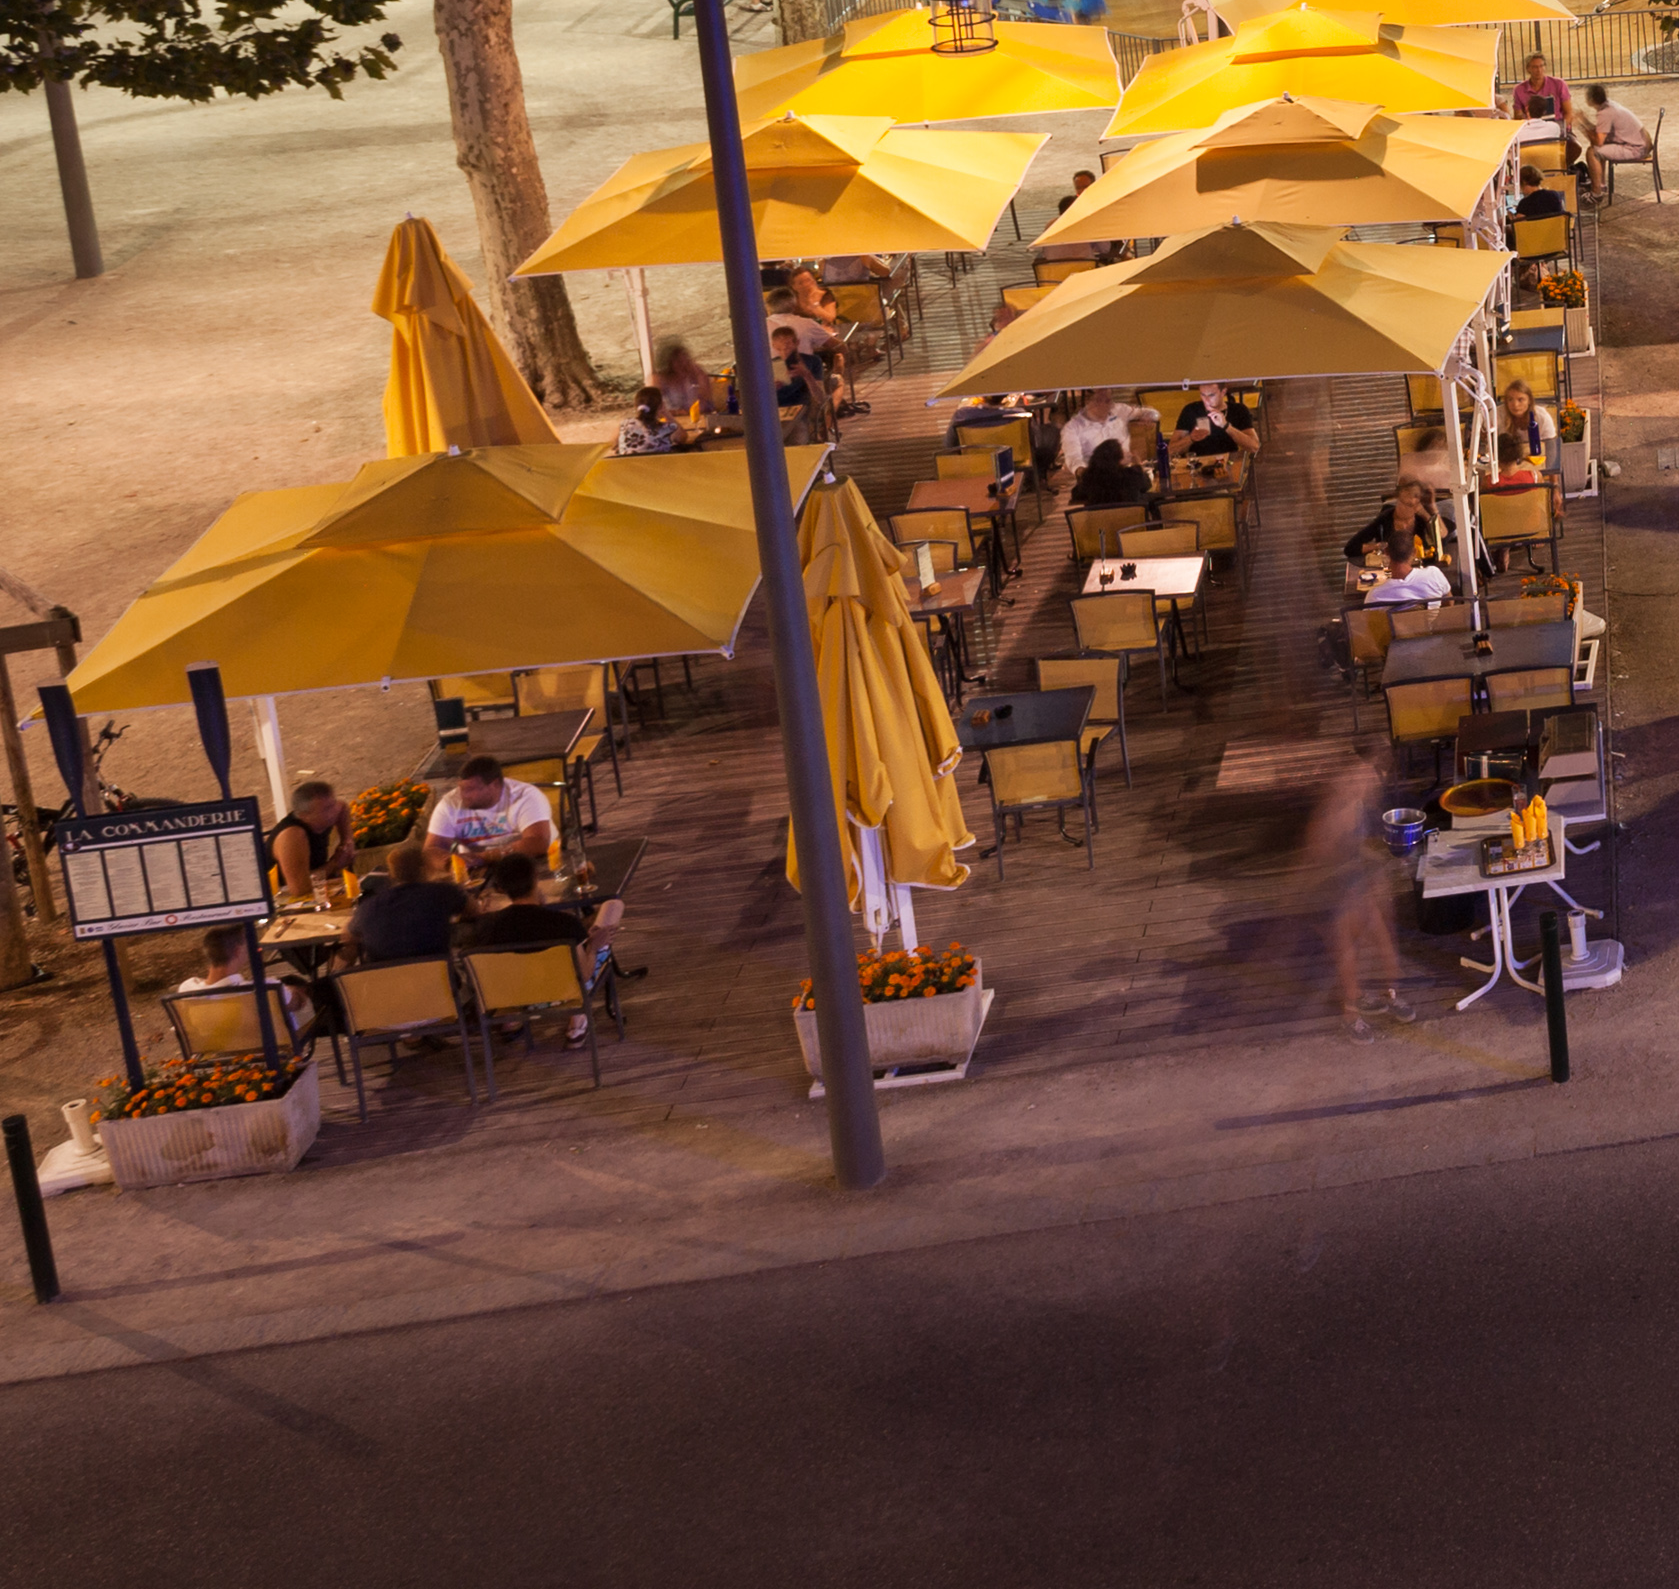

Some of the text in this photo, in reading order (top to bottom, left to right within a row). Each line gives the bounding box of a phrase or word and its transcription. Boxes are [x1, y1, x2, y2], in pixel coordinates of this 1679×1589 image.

[65, 809, 247, 842] LA COMMANDERIE
[180, 910, 231, 923] Restaurant
